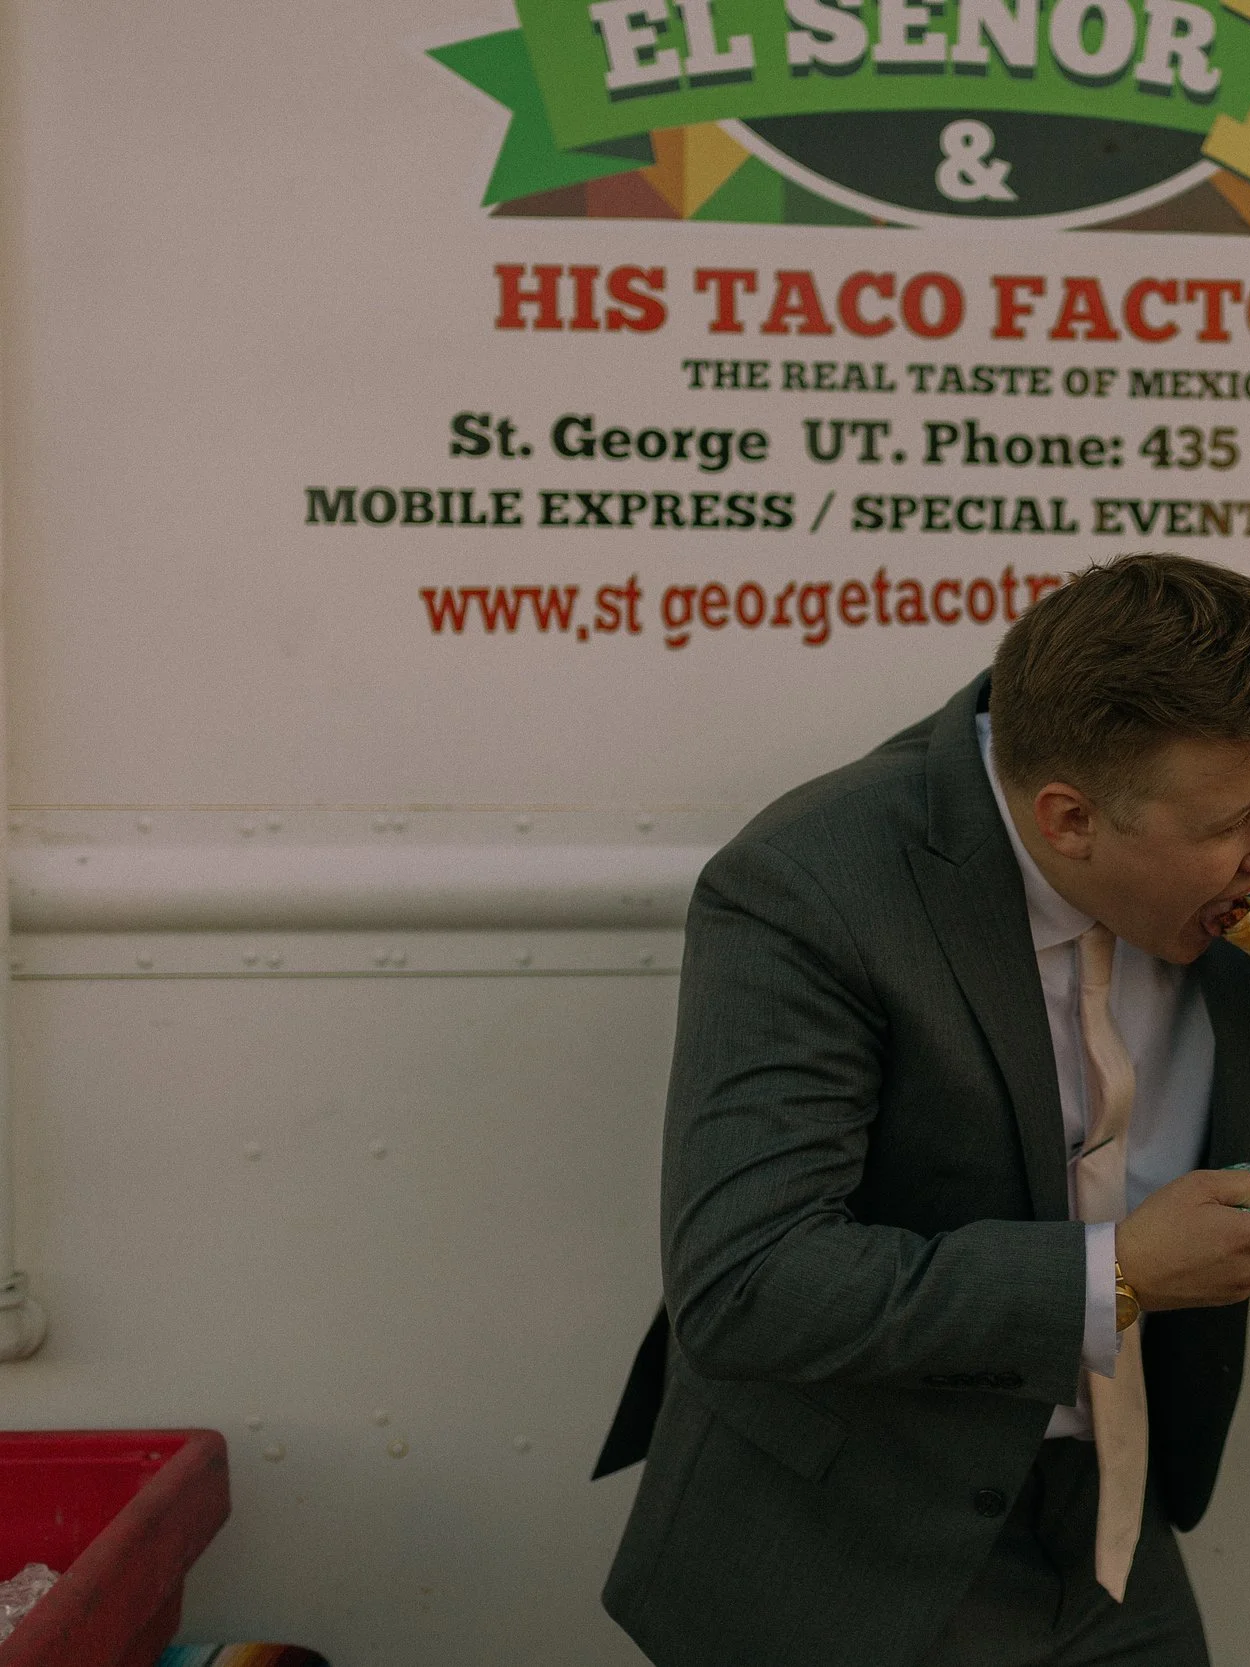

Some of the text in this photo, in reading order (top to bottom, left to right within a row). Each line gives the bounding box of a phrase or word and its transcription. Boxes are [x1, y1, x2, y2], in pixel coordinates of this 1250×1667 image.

[589, 0, 757, 101] EL
[934, 118, 1018, 202] &
[494, 263, 669, 334] HIS
[693, 267, 966, 341] TACO
[681, 359, 771, 391] THE
[781, 360, 897, 394] REAL
[906, 363, 1053, 397] TASTE
[1062, 366, 1119, 398] OF
[449, 411, 534, 460] St.
[550, 413, 770, 474] George
[802, 418, 907, 465] UT.
[922, 418, 1124, 469] Phone:
[1138, 425, 1241, 472] 435
[304, 486, 524, 528] MOBILE
[538, 489, 796, 532] EXPRESS
[851, 493, 1080, 535] SPECIAL
